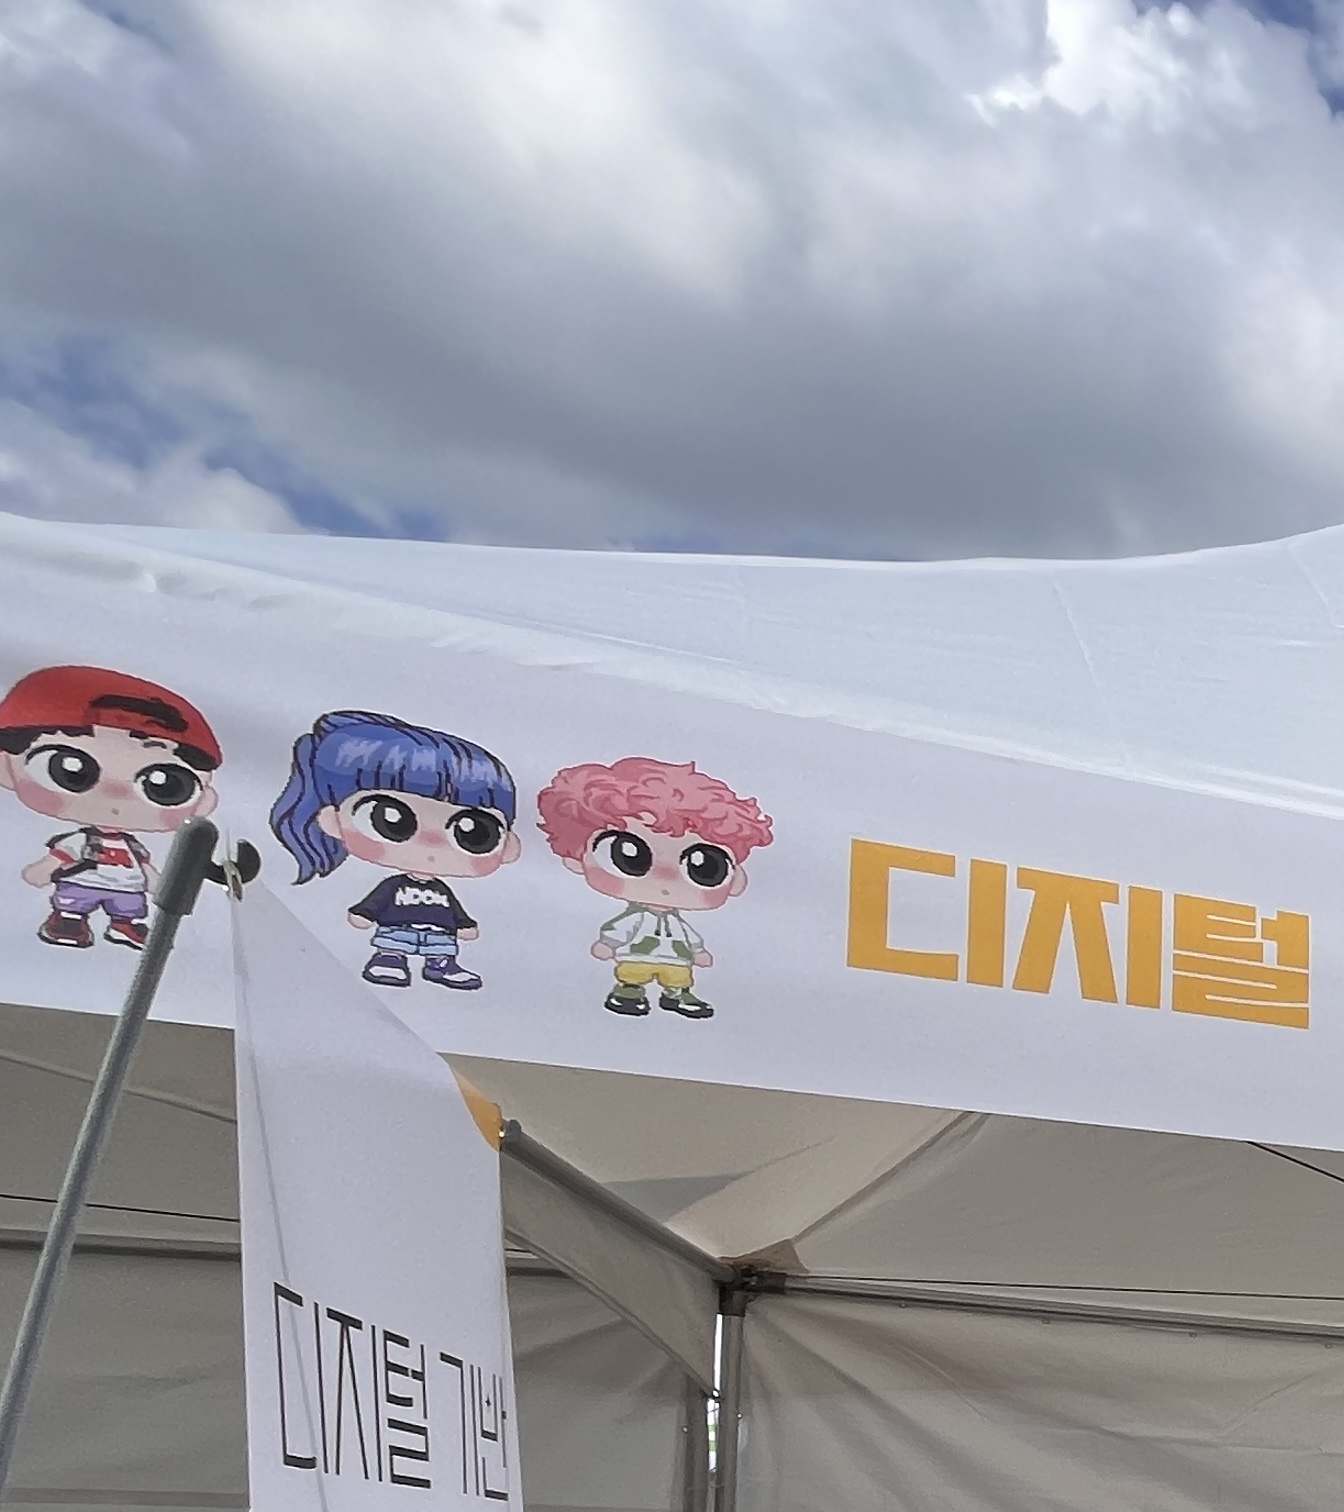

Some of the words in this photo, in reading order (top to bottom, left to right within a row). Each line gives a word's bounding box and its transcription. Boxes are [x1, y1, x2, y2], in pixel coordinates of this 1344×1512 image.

[846, 836, 1309, 1030] 디지털
[273, 1281, 432, 1490] 디지털
[439, 1350, 510, 1502] 기반
